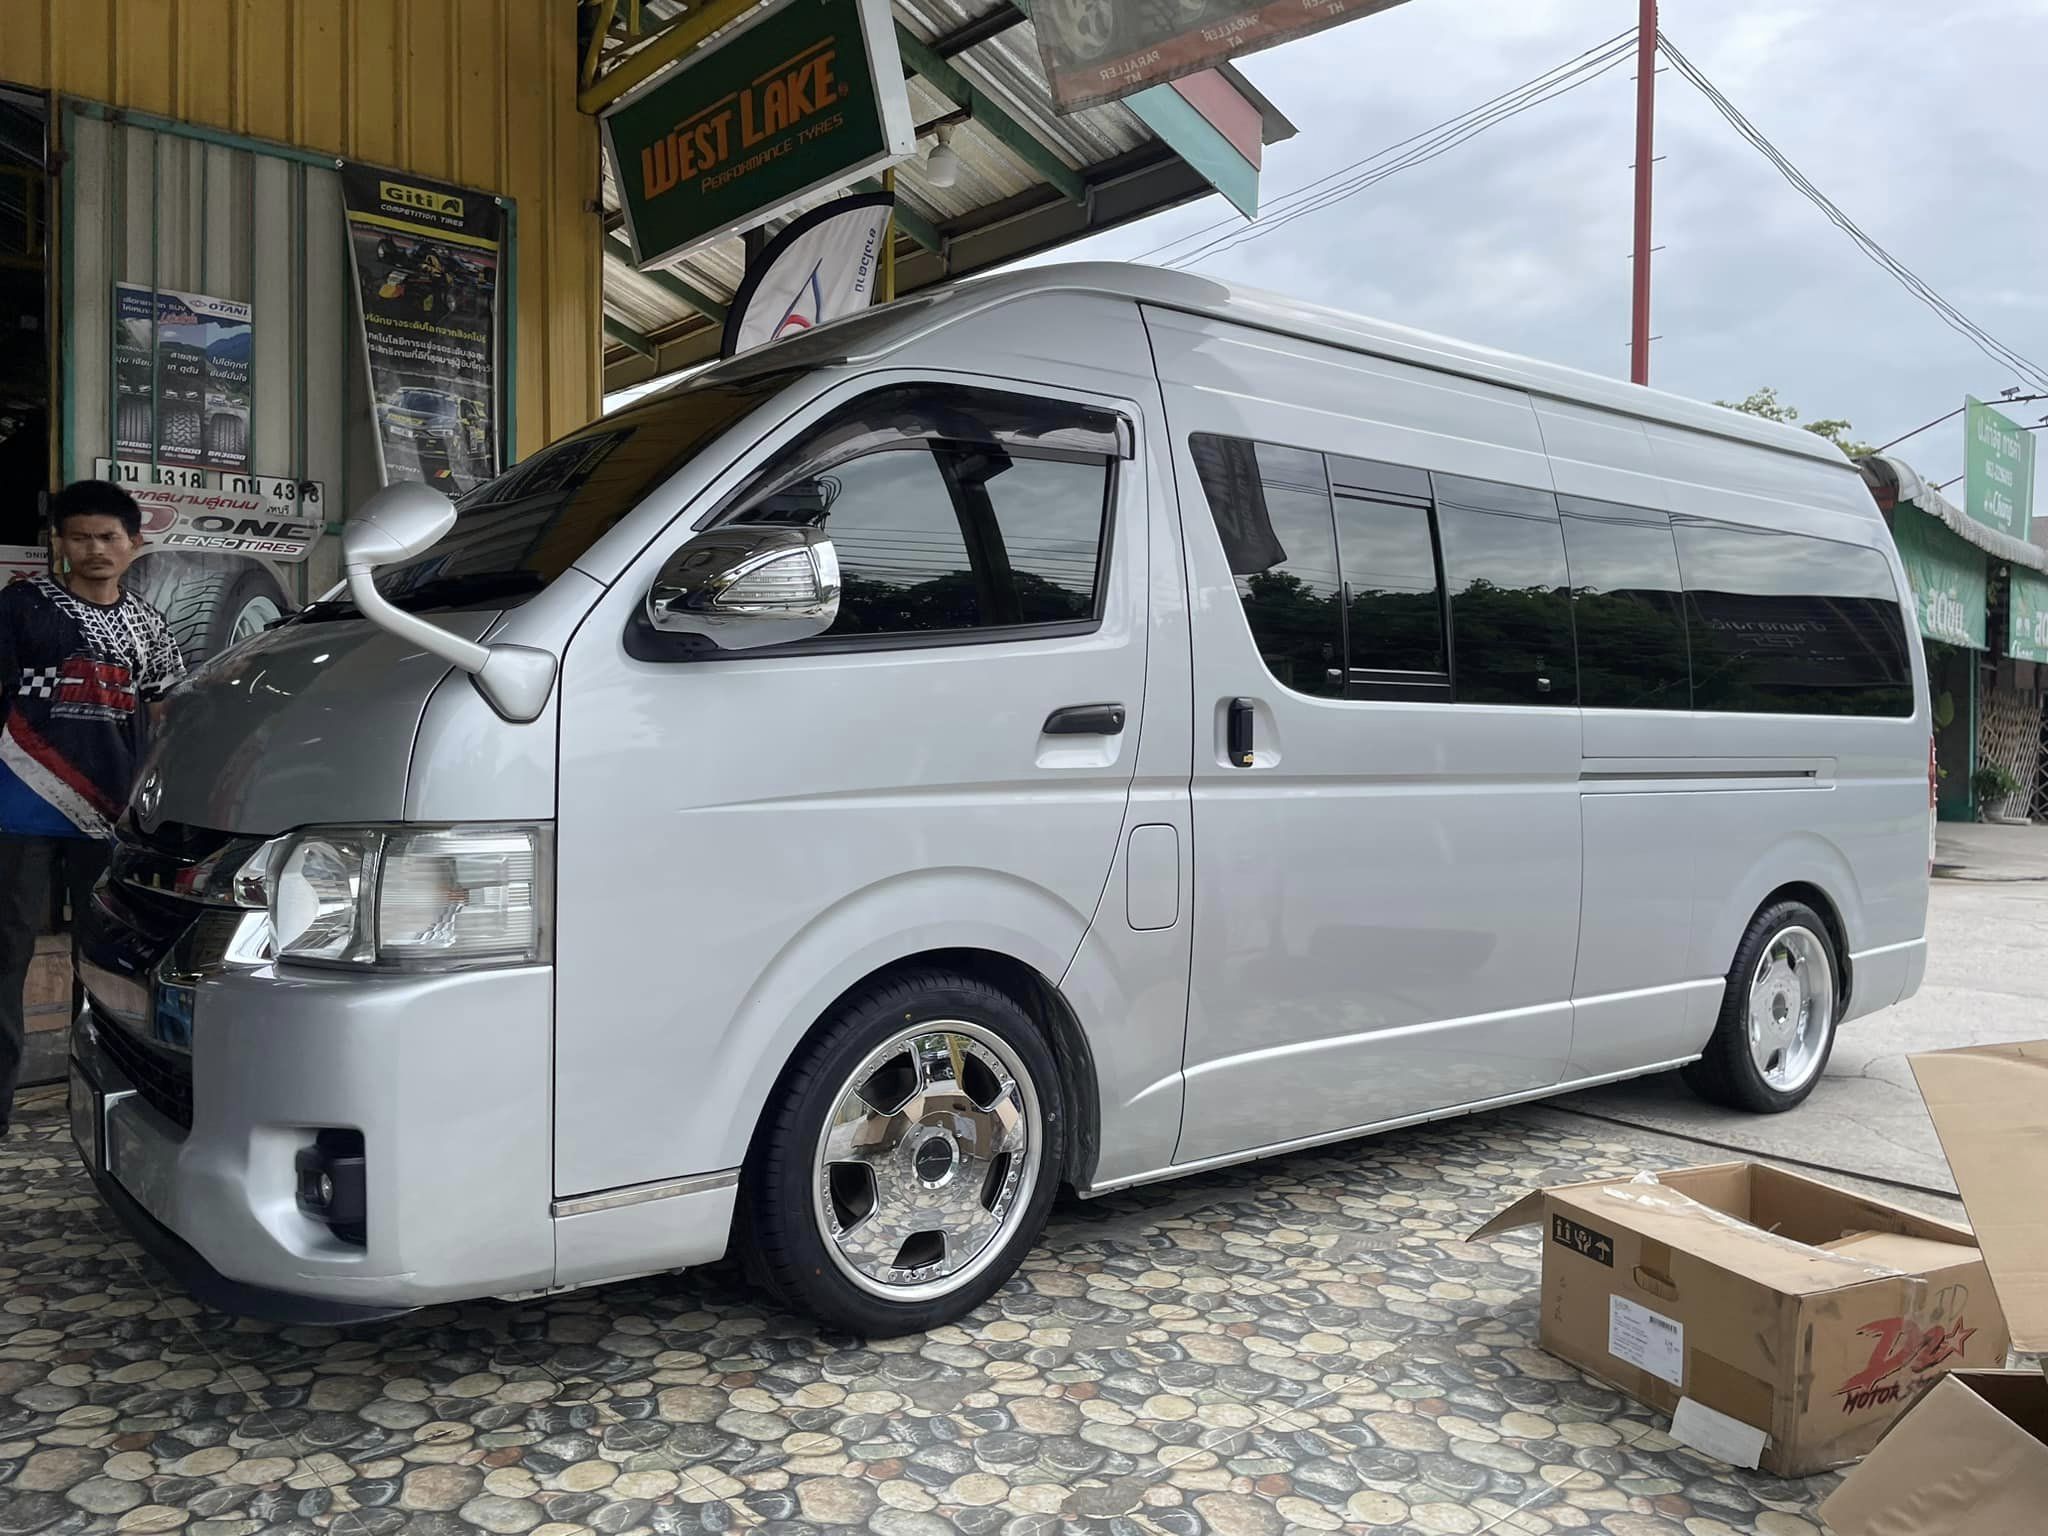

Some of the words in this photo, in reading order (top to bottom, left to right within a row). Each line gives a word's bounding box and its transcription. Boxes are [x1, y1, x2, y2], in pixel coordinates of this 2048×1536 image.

[641, 110, 733, 200] WEST
[739, 50, 838, 149] LAKE
[701, 136, 793, 195] PERFORMANCE
[796, 111, 845, 146] TYRES
[385, 186, 433, 208] Giti
[439, 216, 464, 228] TIRES
[208, 302, 249, 317] OTANI
[168, 534, 239, 548] LENSO
[240, 539, 301, 554] TIRES
[1842, 1383, 1900, 1416] MOTOR
